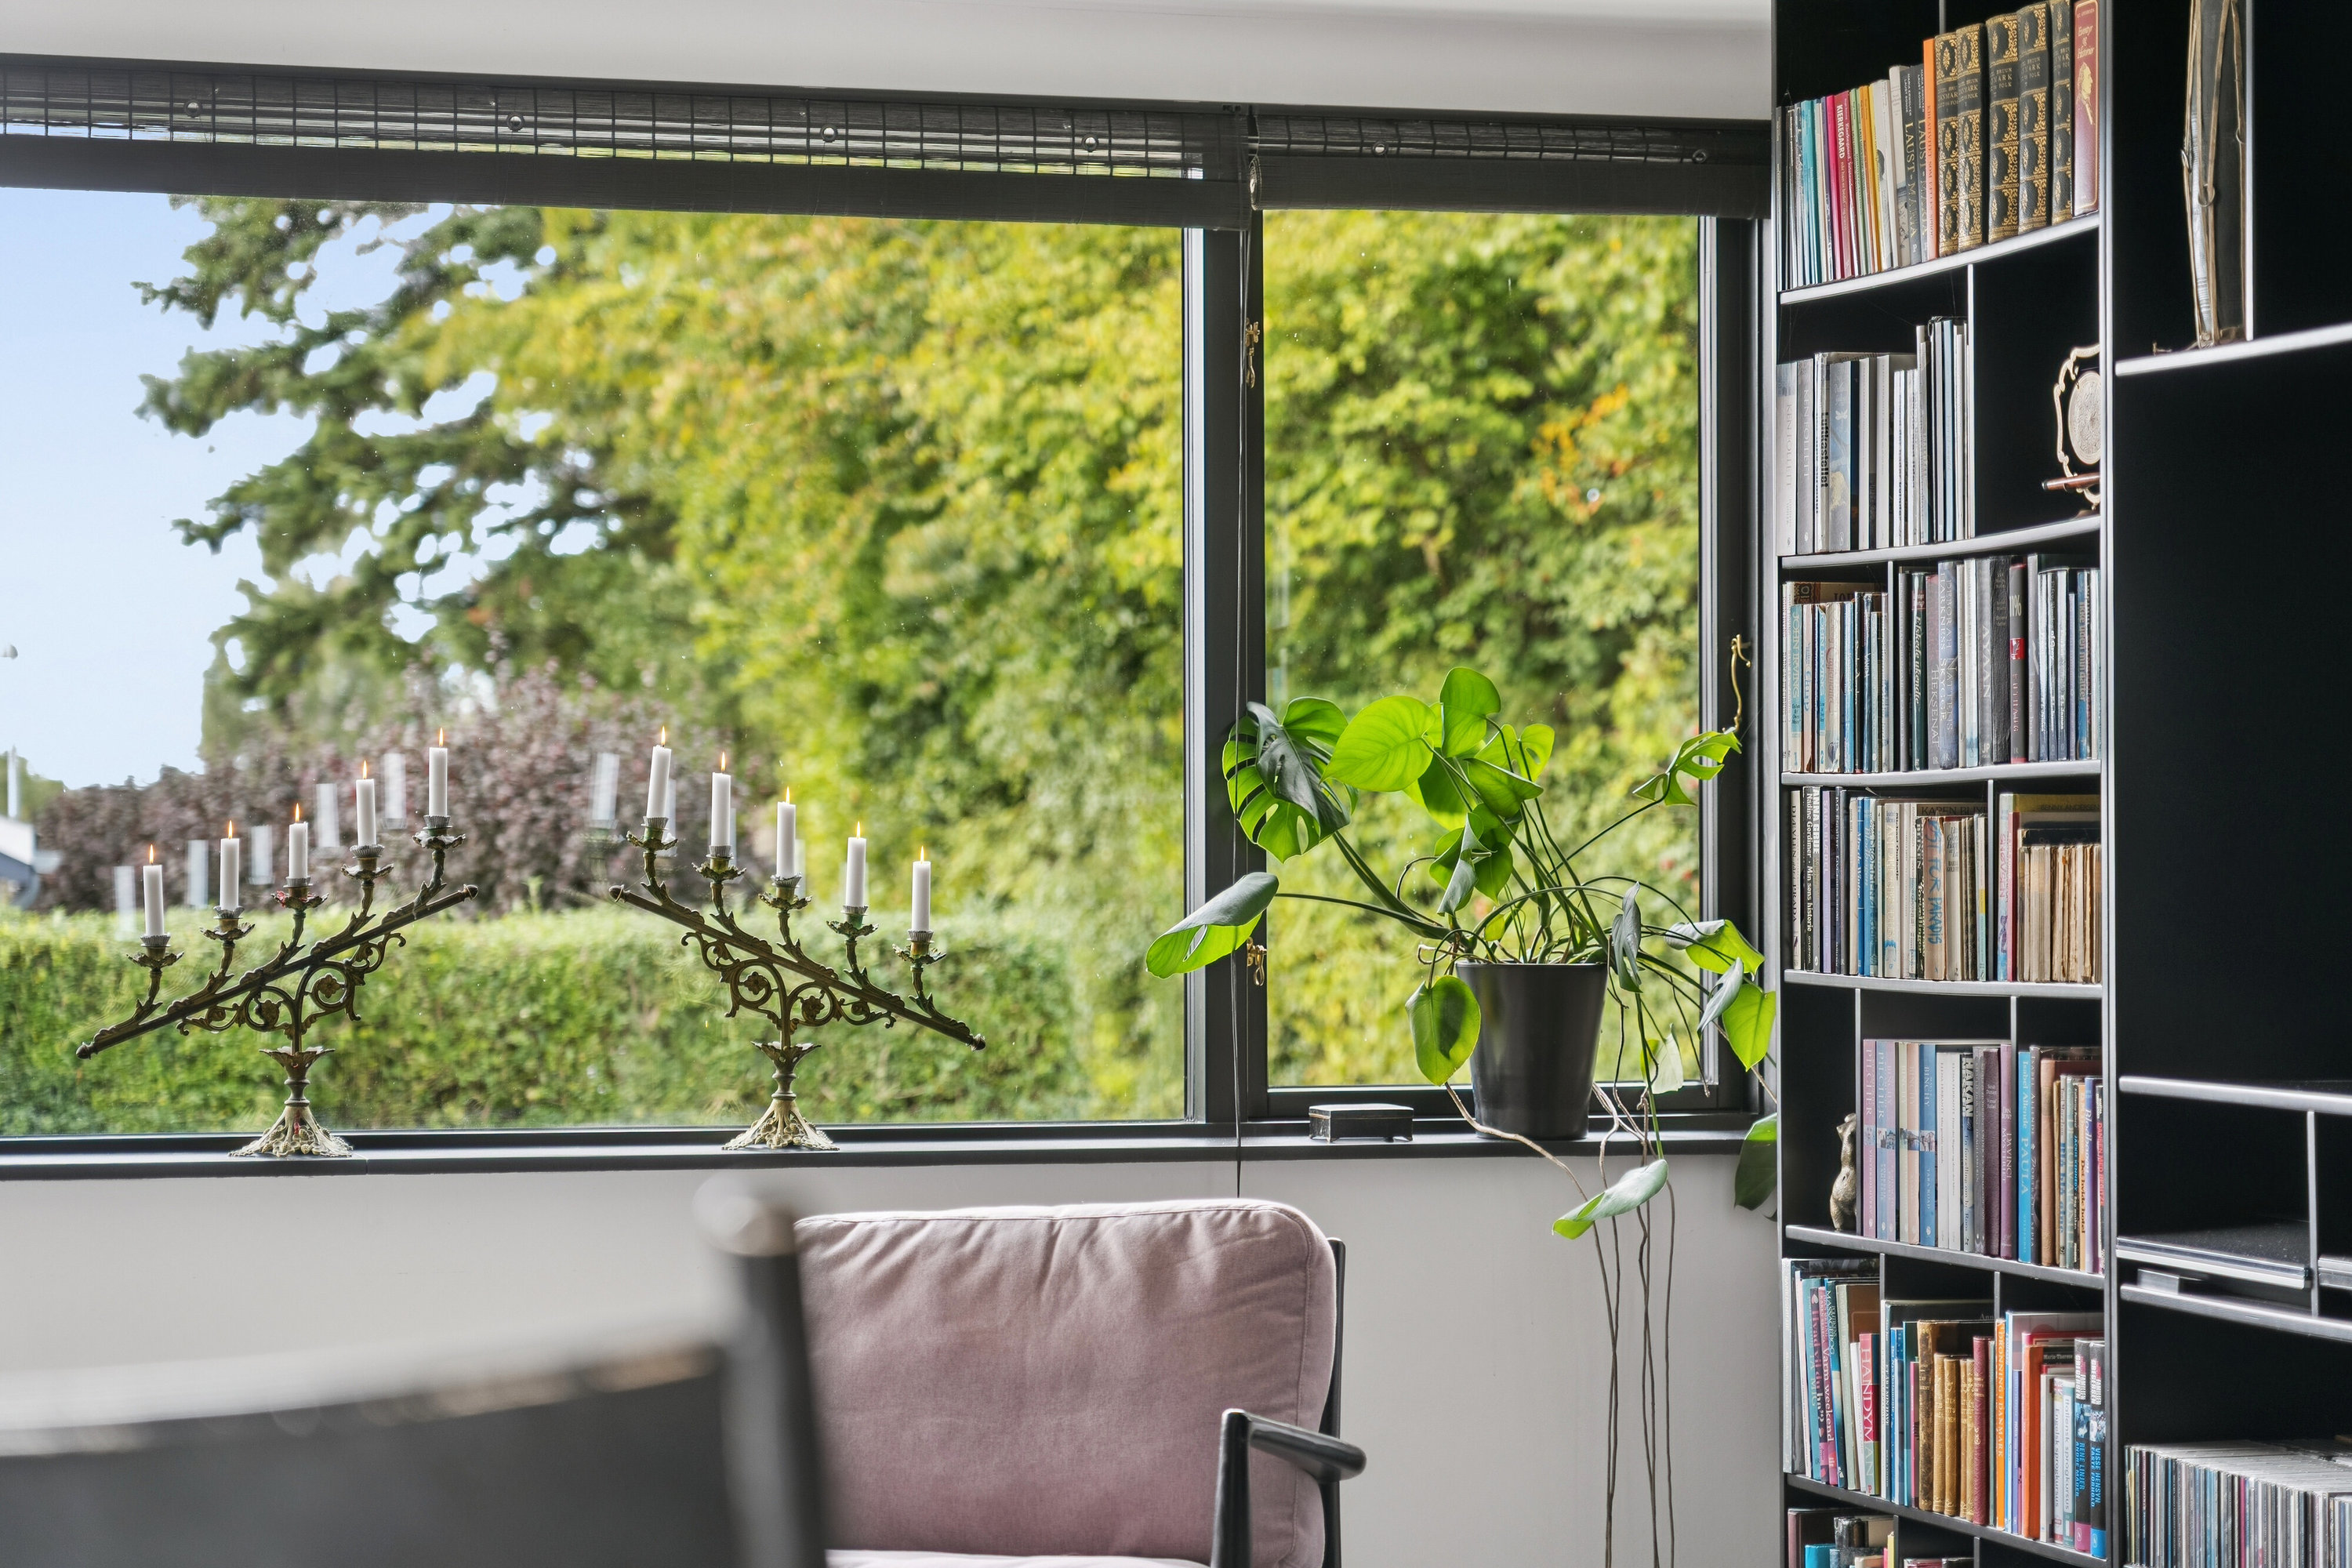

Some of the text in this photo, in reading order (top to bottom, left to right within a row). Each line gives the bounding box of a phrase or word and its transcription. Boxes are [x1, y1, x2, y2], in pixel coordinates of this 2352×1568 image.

[1837, 104, 1846, 159] KIERKEGAARD
[1918, 118, 1926, 169] LAUST
[1905, 122, 1918, 238] LAUST MARIA
[1821, 412, 1830, 488] Luftkastellet
[1947, 655, 1958, 731] NATTENS
[1982, 624, 1991, 698] AYAAN
[1929, 669, 1940, 748] HEKSENAT
[1820, 750, 1824, 764] 2
[1922, 806, 1957, 816] KAREN
[1812, 1309, 1820, 1347] Hvad
[1816, 1371, 1823, 1389] du
[1826, 1290, 1835, 1356] MASSAGEBOG
[1825, 1385, 1835, 1443] weekend
[1861, 1348, 1874, 1477] HANDYMAN
[2063, 1446, 2071, 1510] sprogkursus
